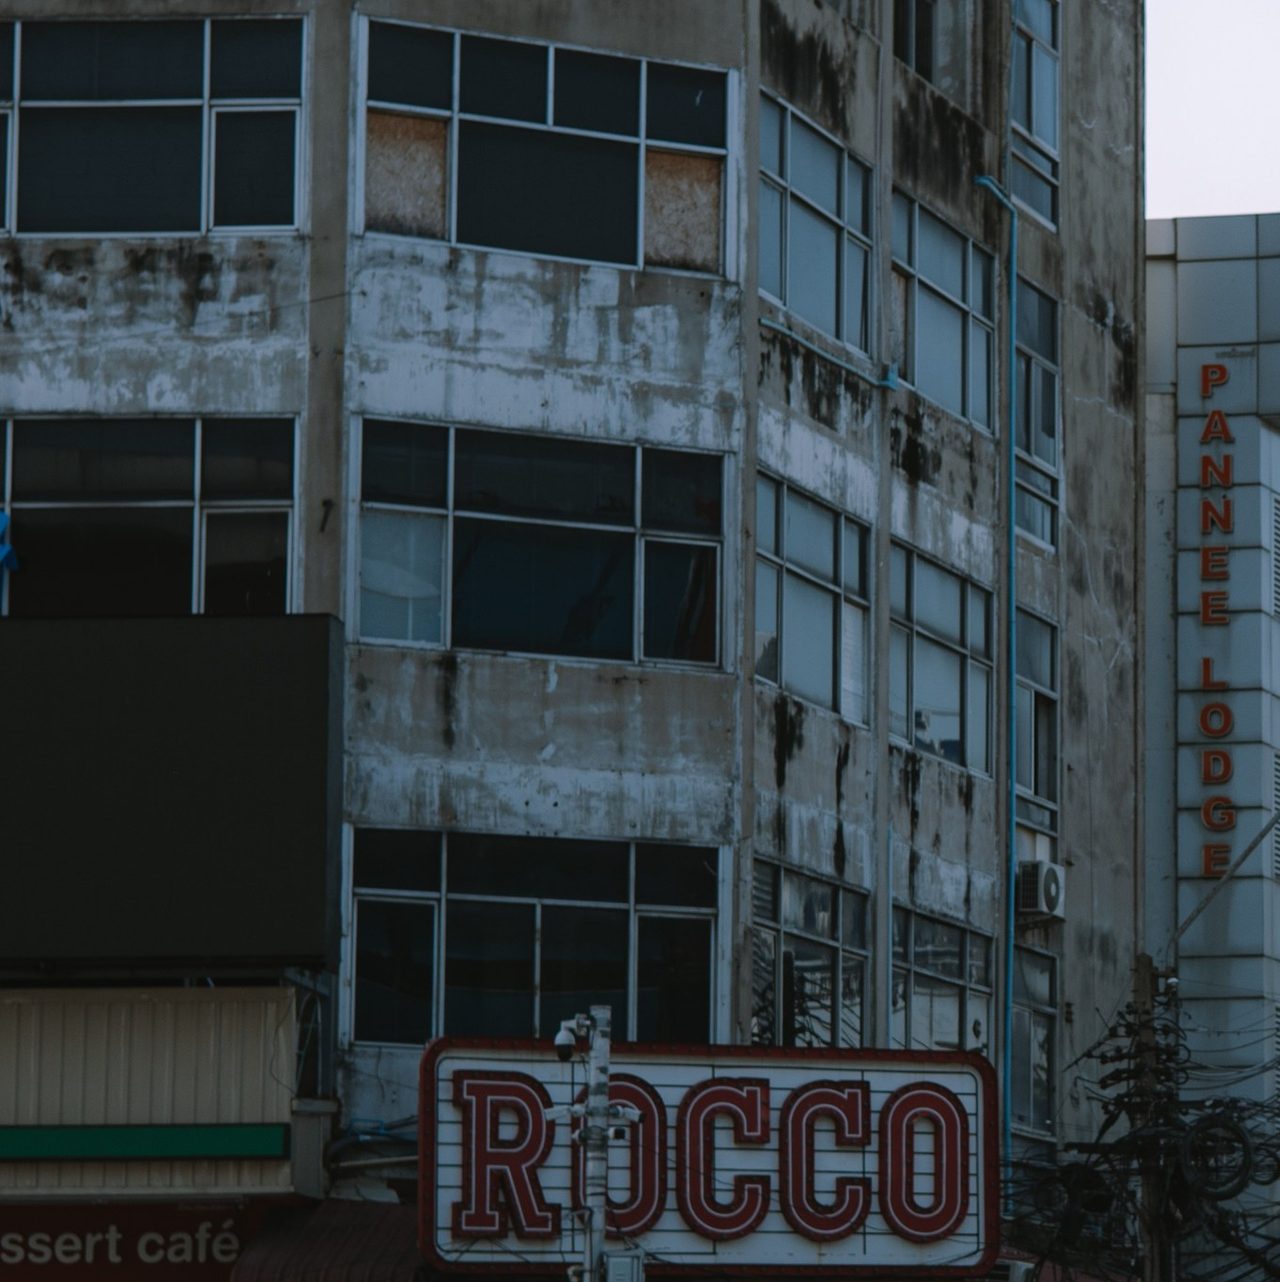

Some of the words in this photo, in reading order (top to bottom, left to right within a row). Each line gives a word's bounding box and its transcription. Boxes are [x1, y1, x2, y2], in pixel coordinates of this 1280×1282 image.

[1200, 363, 1234, 626] PANNEE
[1198, 657, 1237, 878] LODGE
[137, 1218, 241, 1265] café
[451, 1069, 971, 1244] ROCCO
